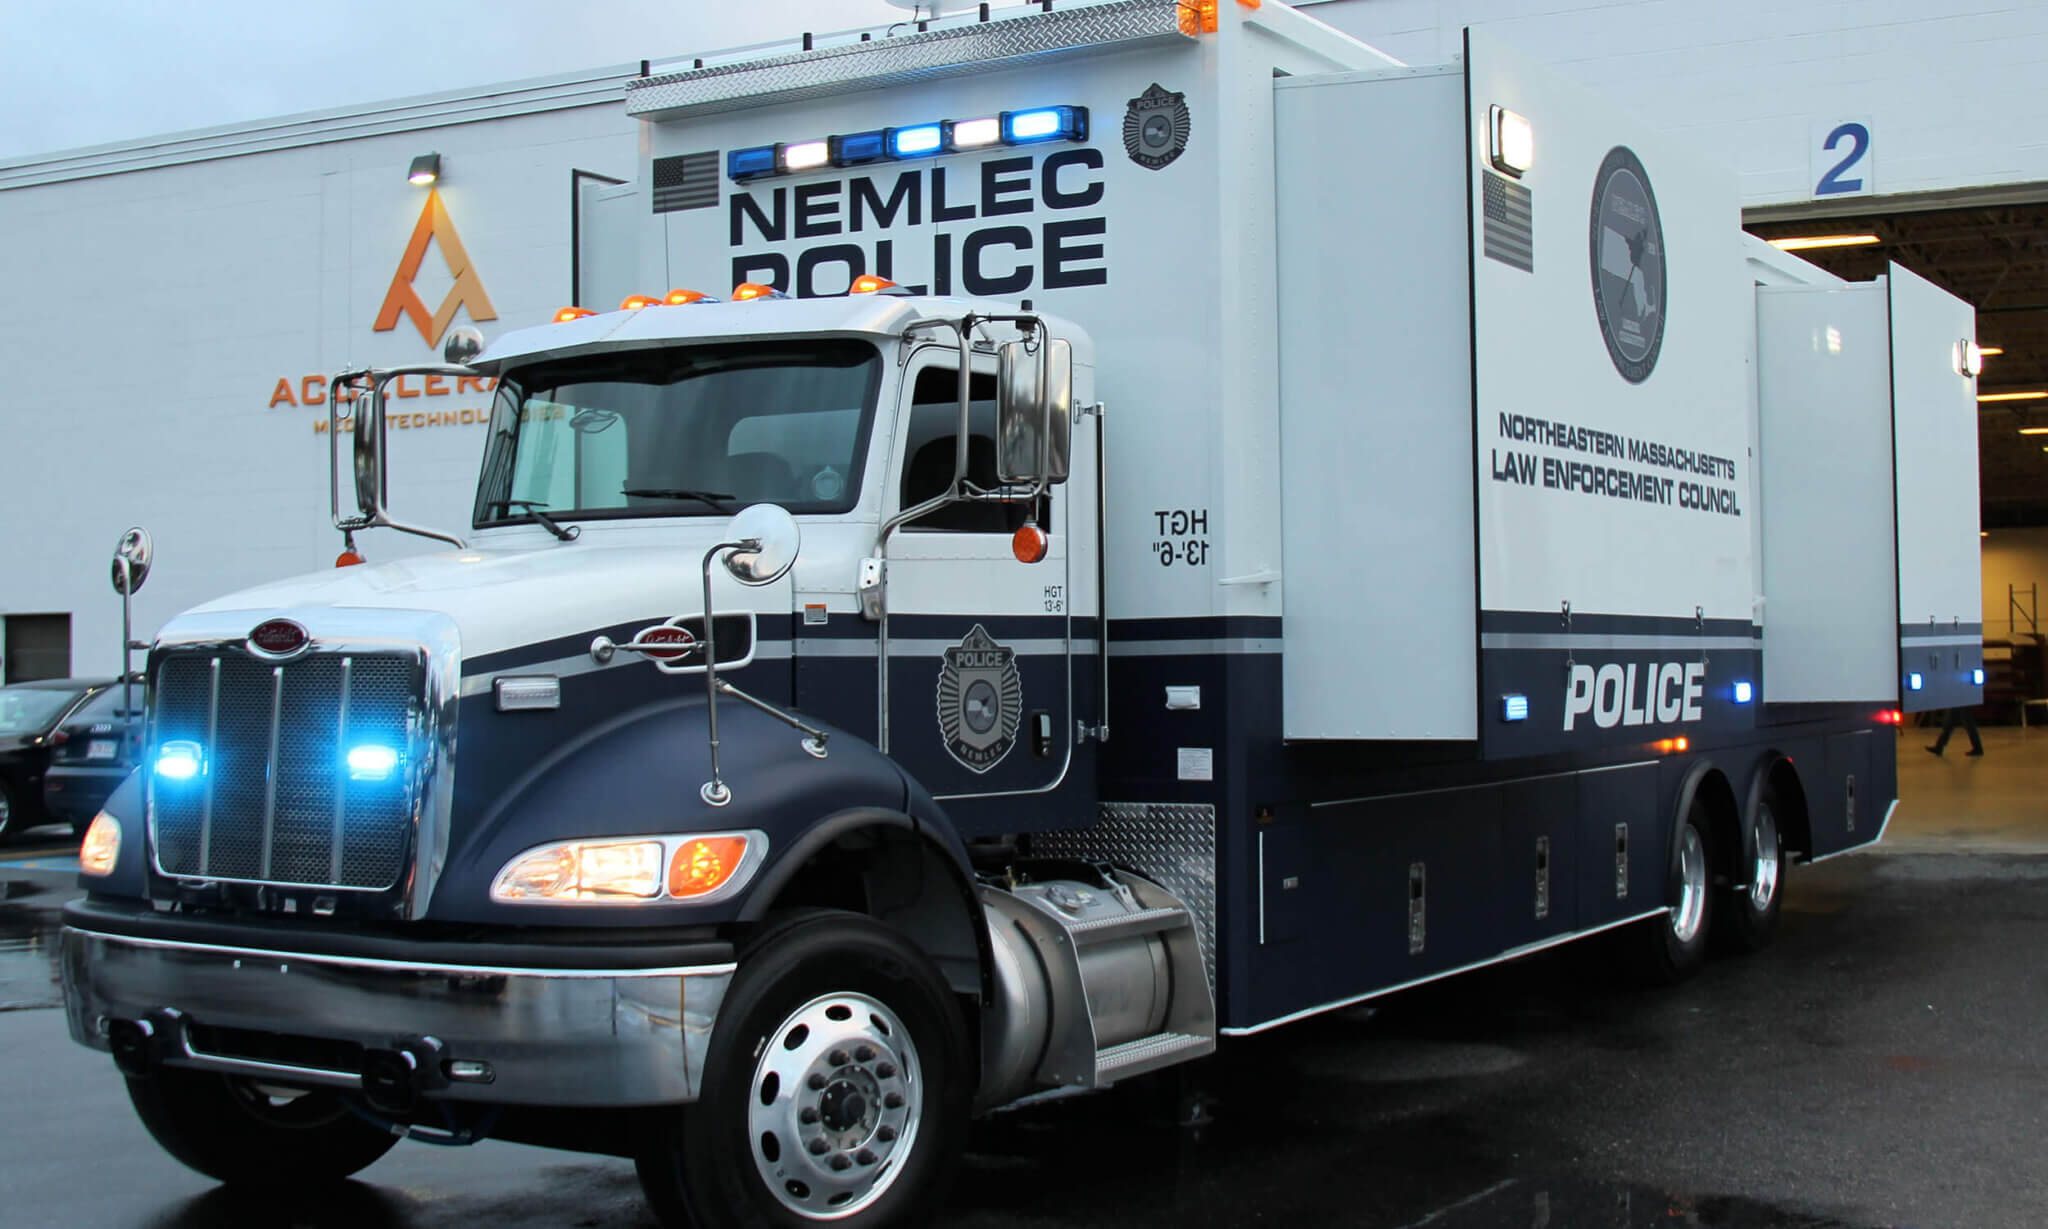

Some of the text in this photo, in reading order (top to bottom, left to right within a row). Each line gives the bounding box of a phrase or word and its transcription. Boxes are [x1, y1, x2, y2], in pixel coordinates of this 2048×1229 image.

[1136, 96, 1175, 111] POLICE
[1815, 122, 1870, 196] 2
[729, 148, 1104, 247] NEMLEC
[731, 216, 1108, 299] POLICE
[1499, 411, 1736, 480] NORTHEASTERN MASSACHUSETTS
[1491, 448, 1741, 517] LAW ENFORCEMENT COUNCIL
[1044, 585, 1063, 598] HGT
[956, 652, 1003, 668] POLICE
[1563, 662, 1705, 731] POLICE
